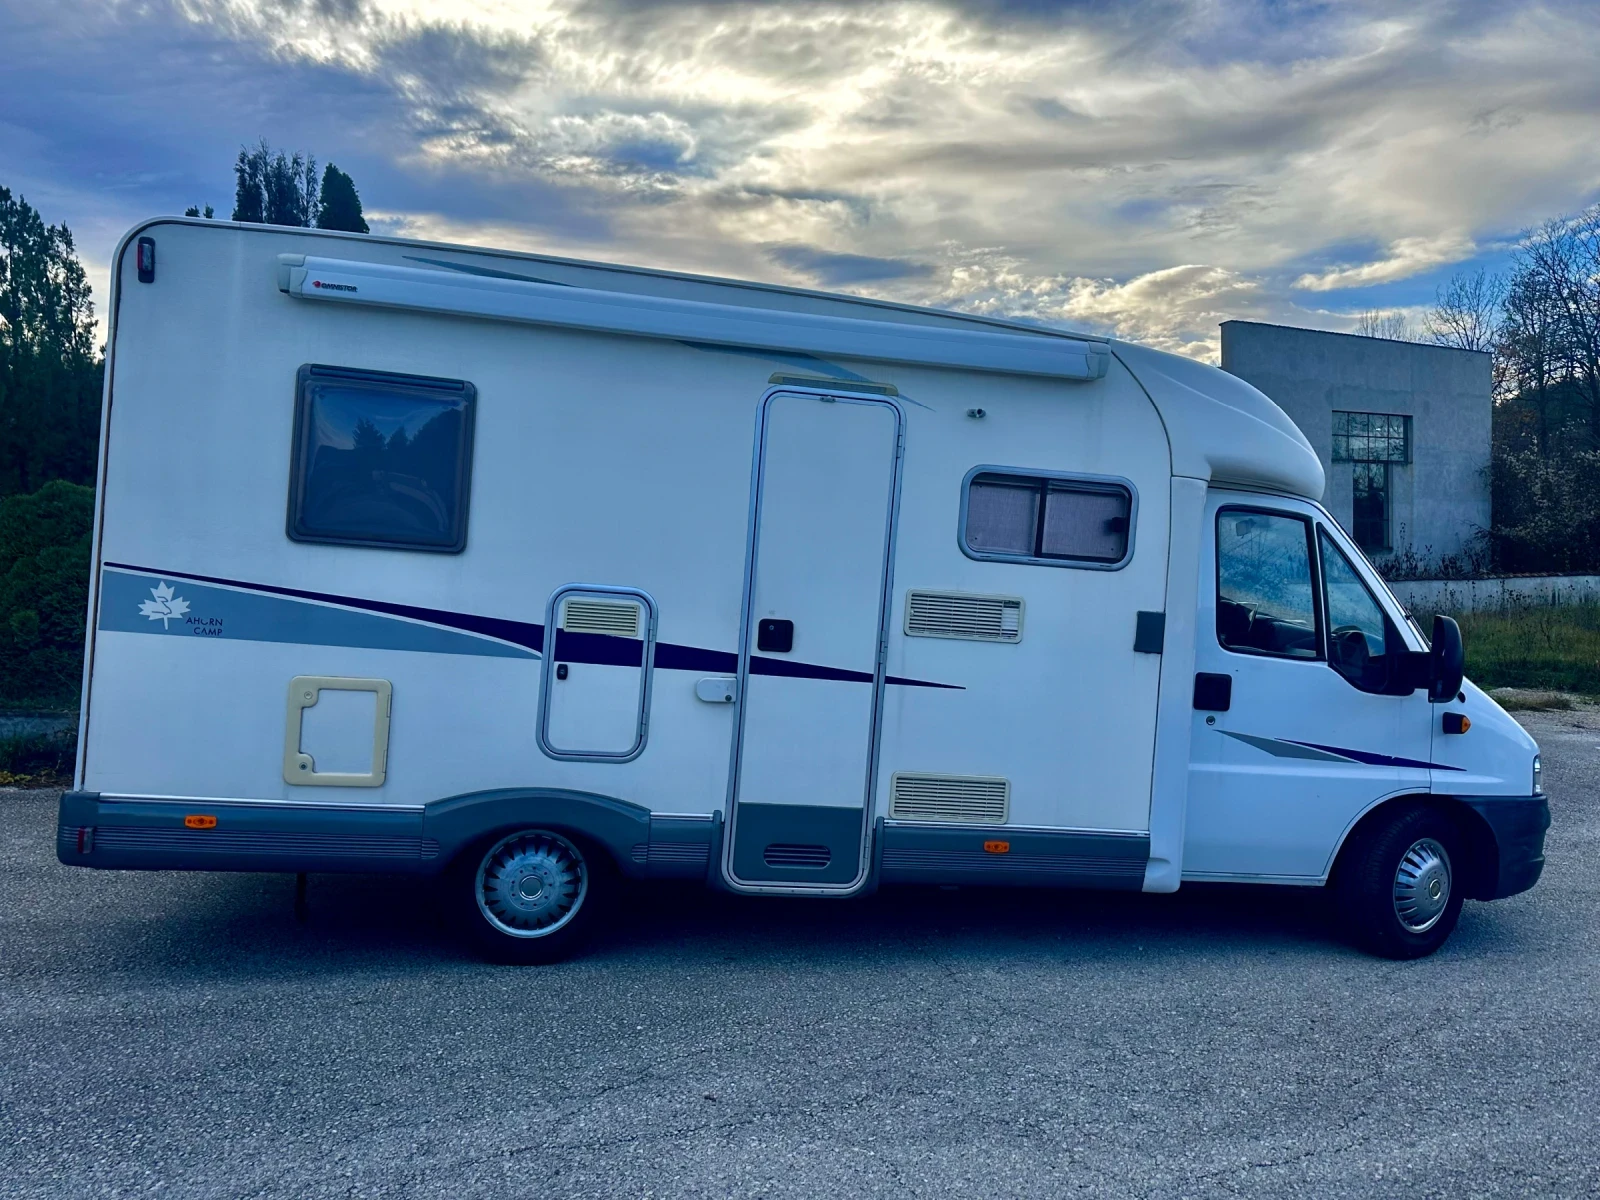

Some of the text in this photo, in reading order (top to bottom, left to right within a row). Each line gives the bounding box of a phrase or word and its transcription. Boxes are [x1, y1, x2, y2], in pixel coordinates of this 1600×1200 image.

[321, 282, 358, 293] OMNISTOR
[186, 616, 223, 626] AHORN
[193, 627, 223, 636] CAMP
